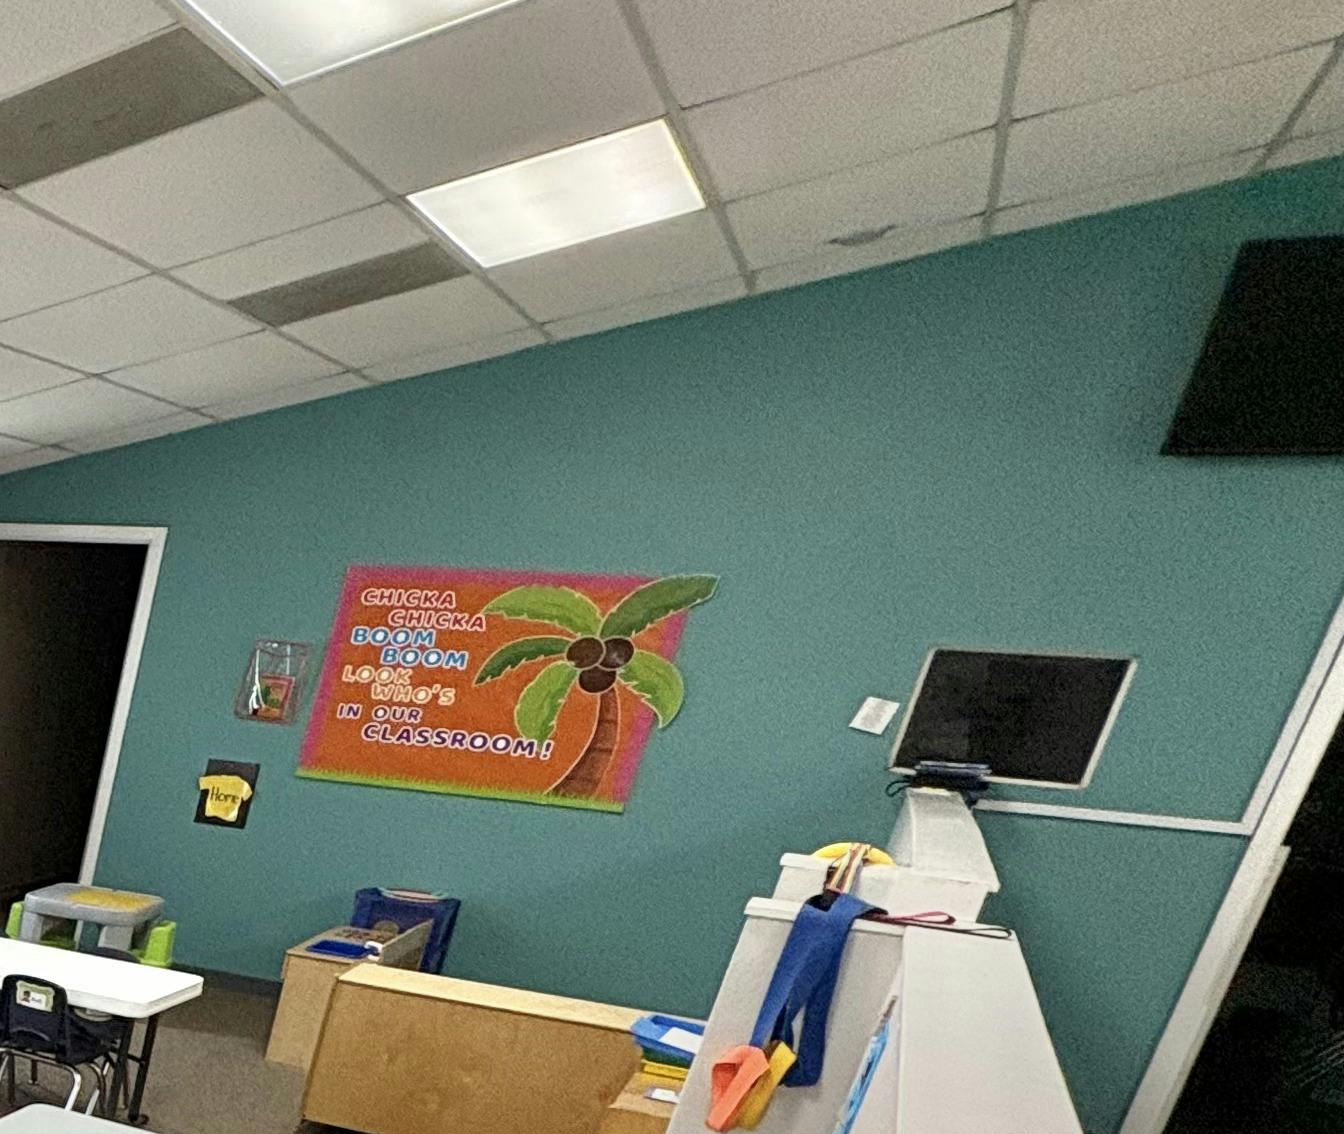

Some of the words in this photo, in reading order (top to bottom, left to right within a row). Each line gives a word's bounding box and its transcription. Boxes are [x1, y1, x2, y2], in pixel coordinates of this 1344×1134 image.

[362, 589, 456, 608] CHICKA
[389, 611, 486, 631] CHICKA
[352, 626, 436, 647] BOOM
[382, 647, 468, 669] BOOM
[342, 665, 413, 684] LOOK
[372, 683, 455, 705] WHO'S
[338, 703, 362, 720] IN
[372, 706, 422, 722] OUR
